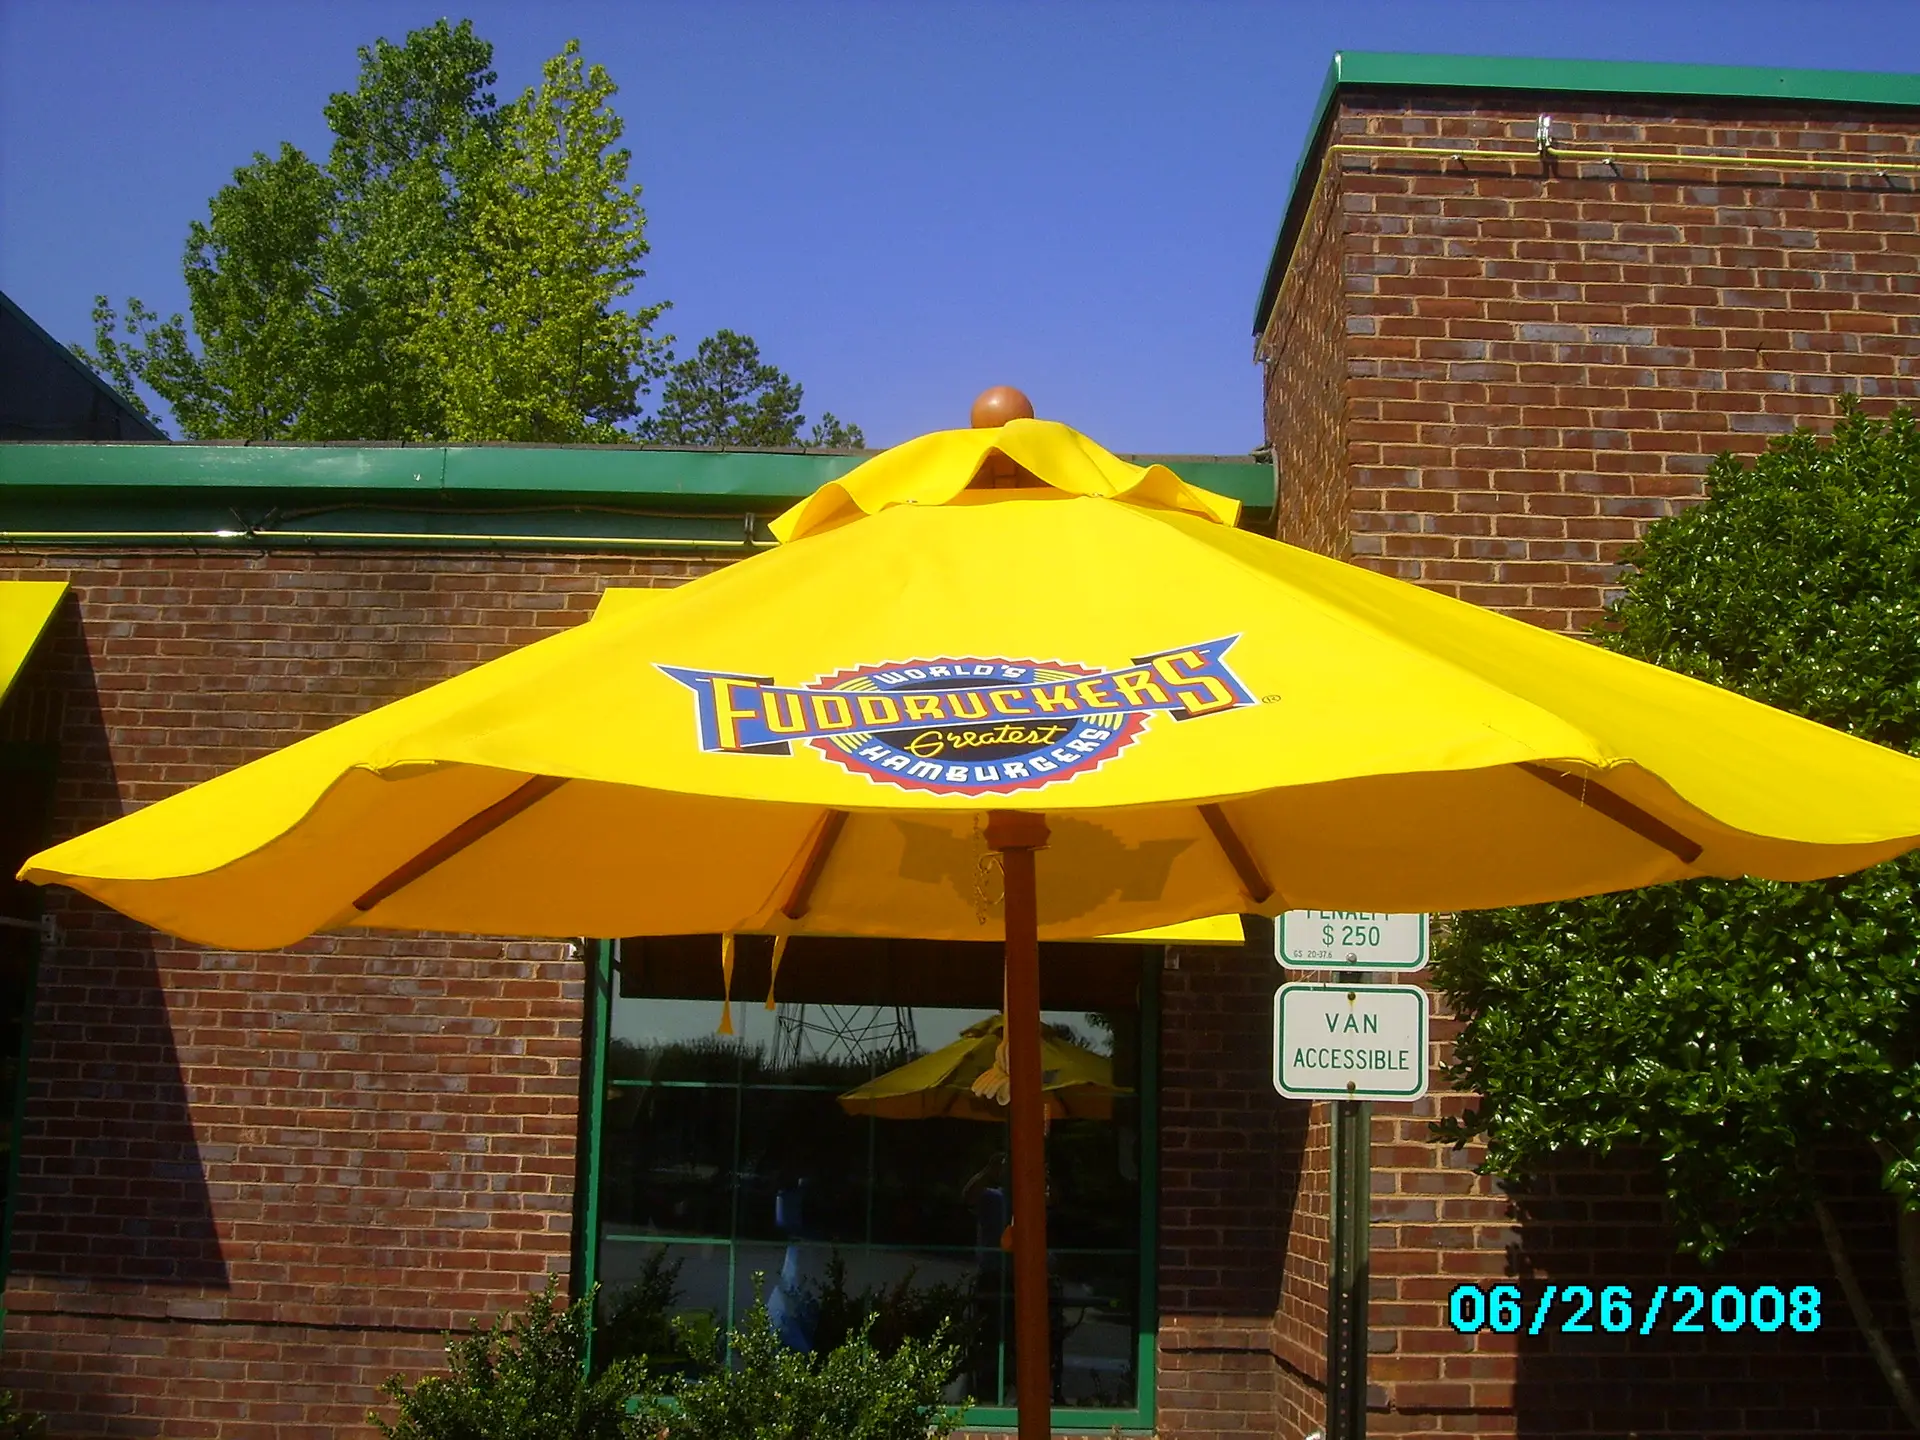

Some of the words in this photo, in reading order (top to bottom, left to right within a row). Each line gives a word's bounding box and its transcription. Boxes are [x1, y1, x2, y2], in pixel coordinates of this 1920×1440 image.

[873, 664, 1027, 685] WORLD'S
[711, 650, 1240, 750] FUDDRUCKERS
[858, 727, 1111, 783] HAMBURGERS
[904, 724, 1068, 758] Greatest
[1325, 1013, 1378, 1034] VAN
[1293, 1048, 1410, 1070] ACCESSIBLE
